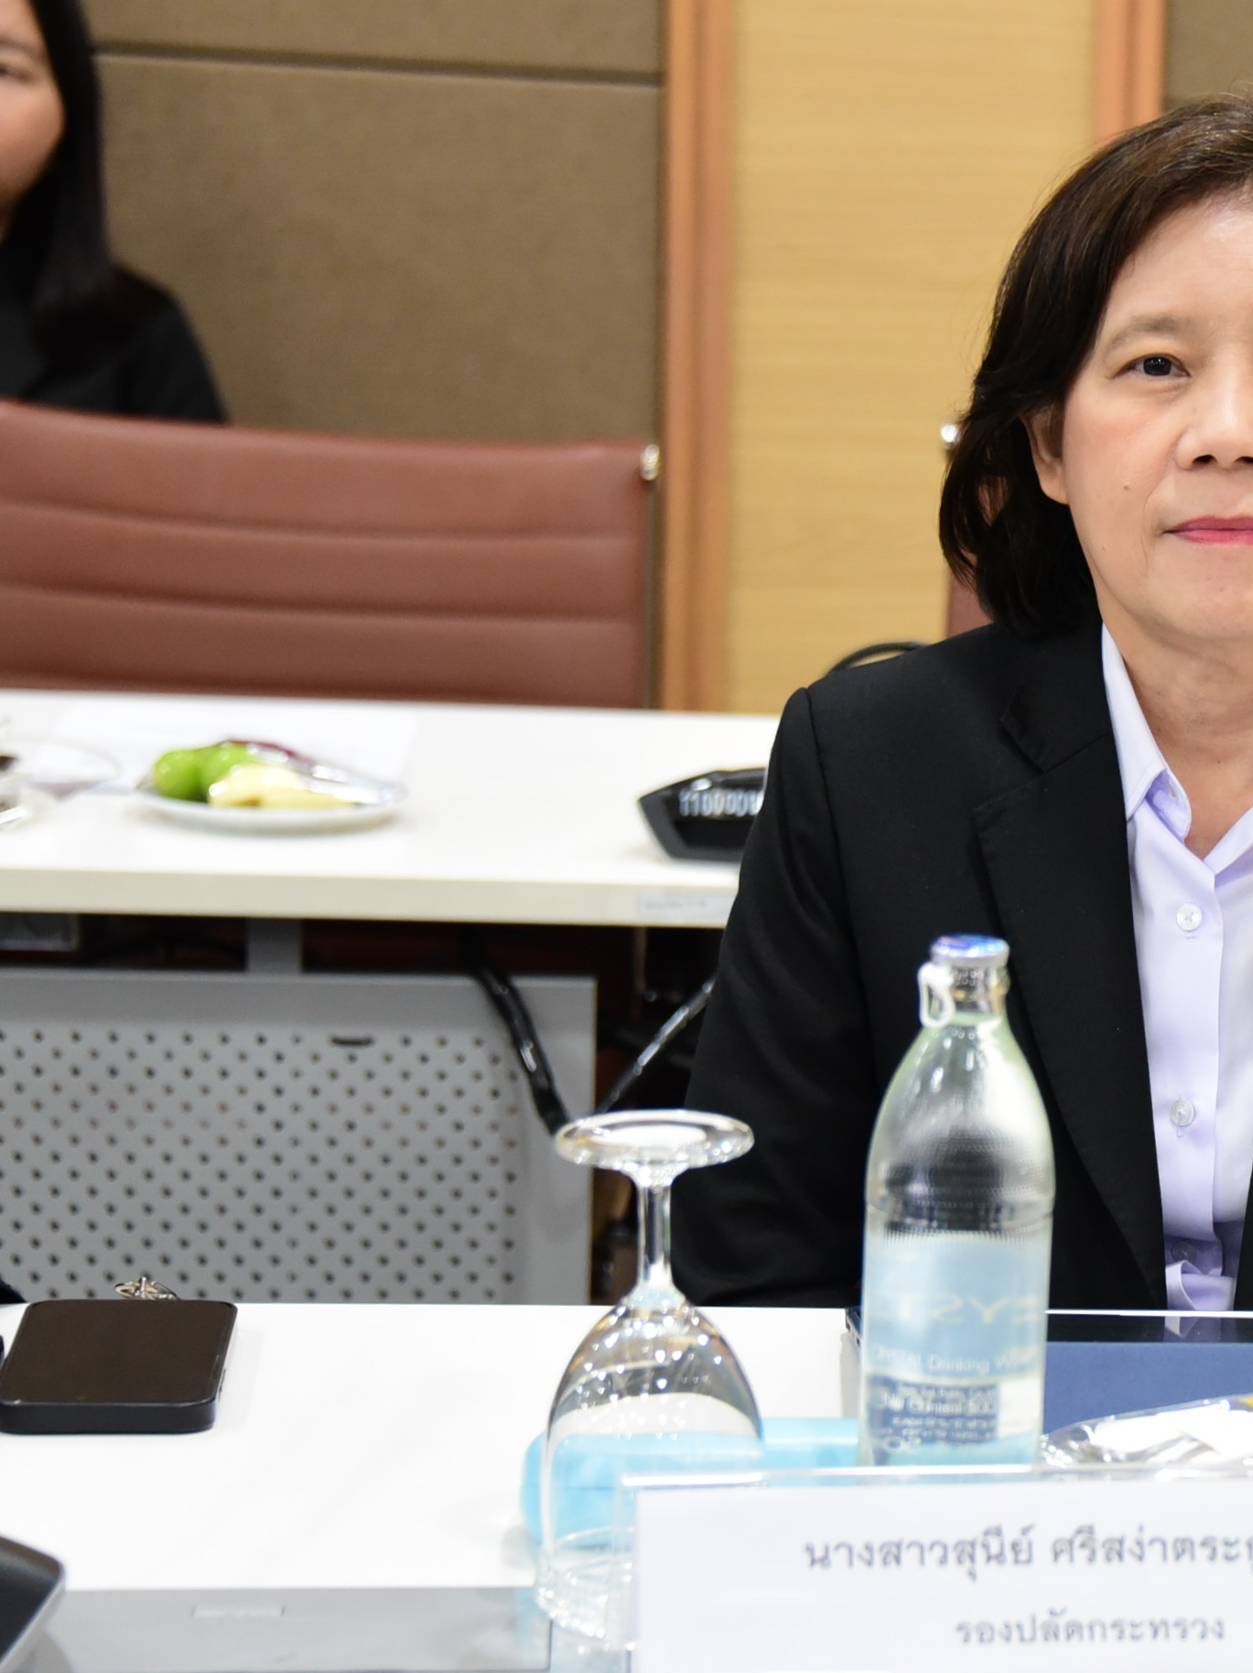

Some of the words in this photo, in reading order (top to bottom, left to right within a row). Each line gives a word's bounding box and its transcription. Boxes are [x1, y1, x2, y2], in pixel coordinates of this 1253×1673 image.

[805, 1523, 1035, 1582] นางสาวสุนีย์
[955, 1606, 1227, 1644] รองปลัดกระทรวง
